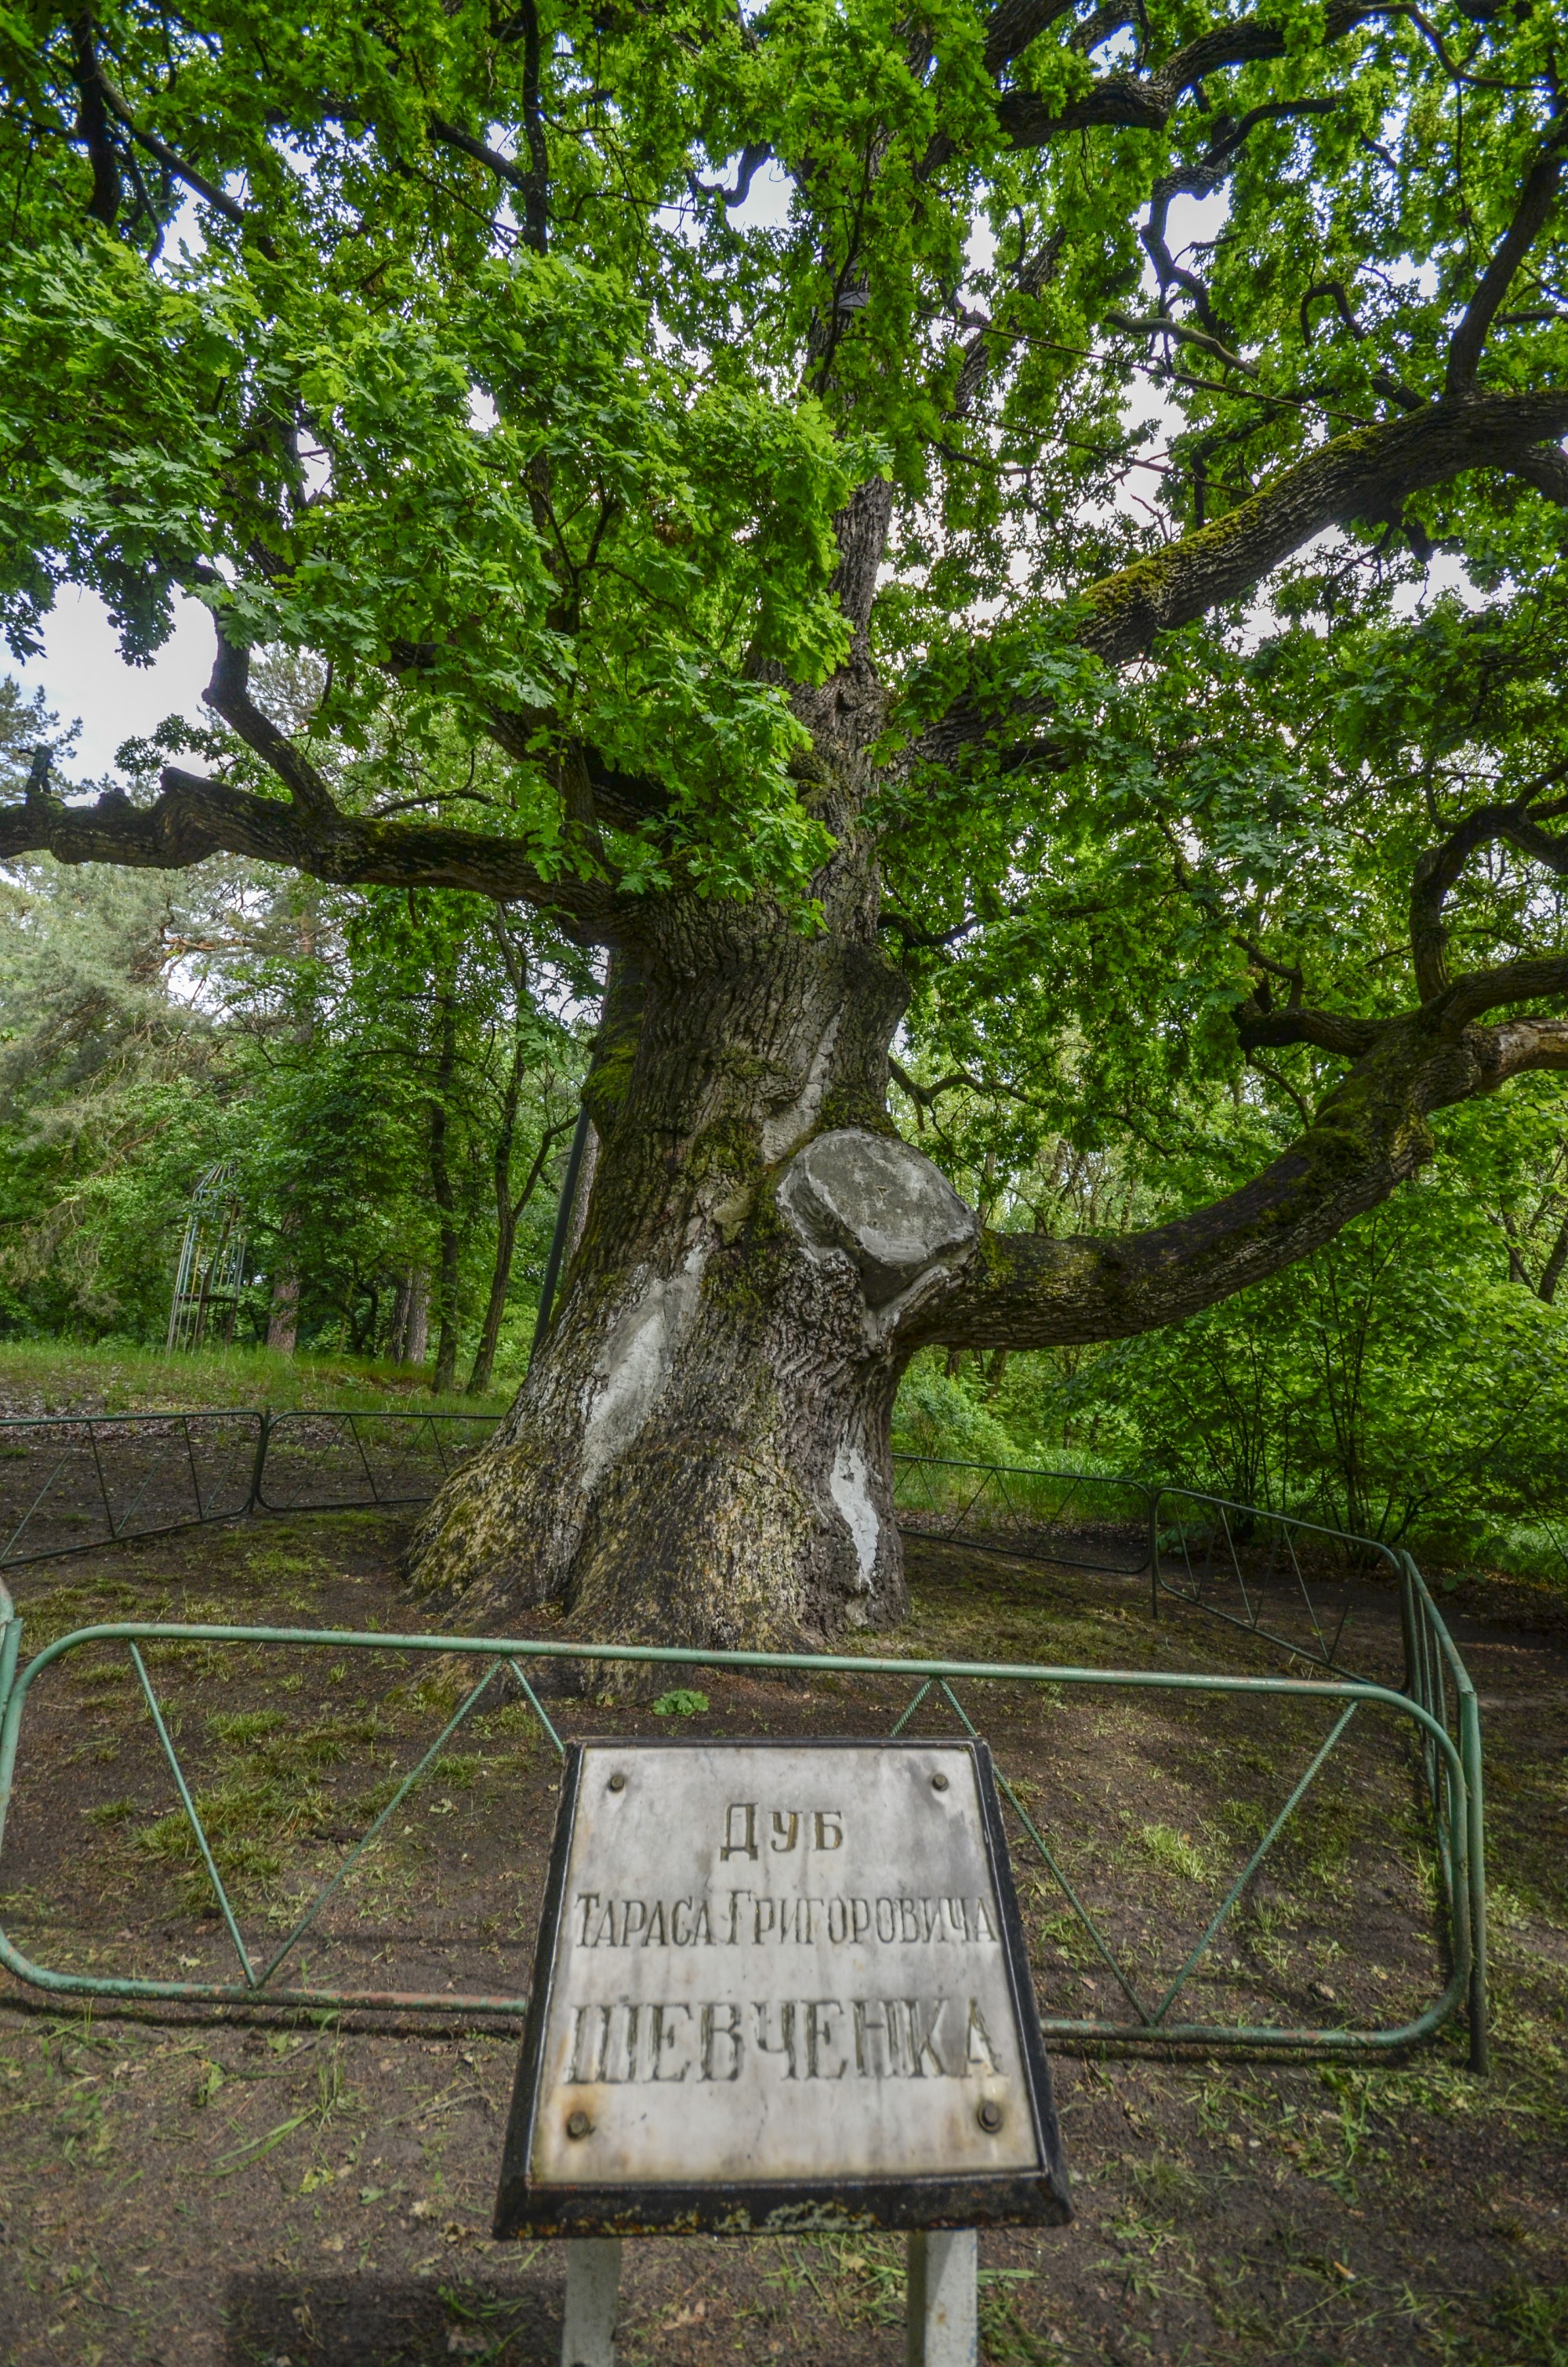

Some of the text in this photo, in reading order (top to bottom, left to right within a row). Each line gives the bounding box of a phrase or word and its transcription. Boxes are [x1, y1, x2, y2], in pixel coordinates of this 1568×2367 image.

[720, 1802, 844, 1862] ДУБ
[573, 1889, 998, 1948] ТАРАСА ГРИГОРОВИЧА
[564, 1996, 1009, 2085] ШЕВЧЕНКА
